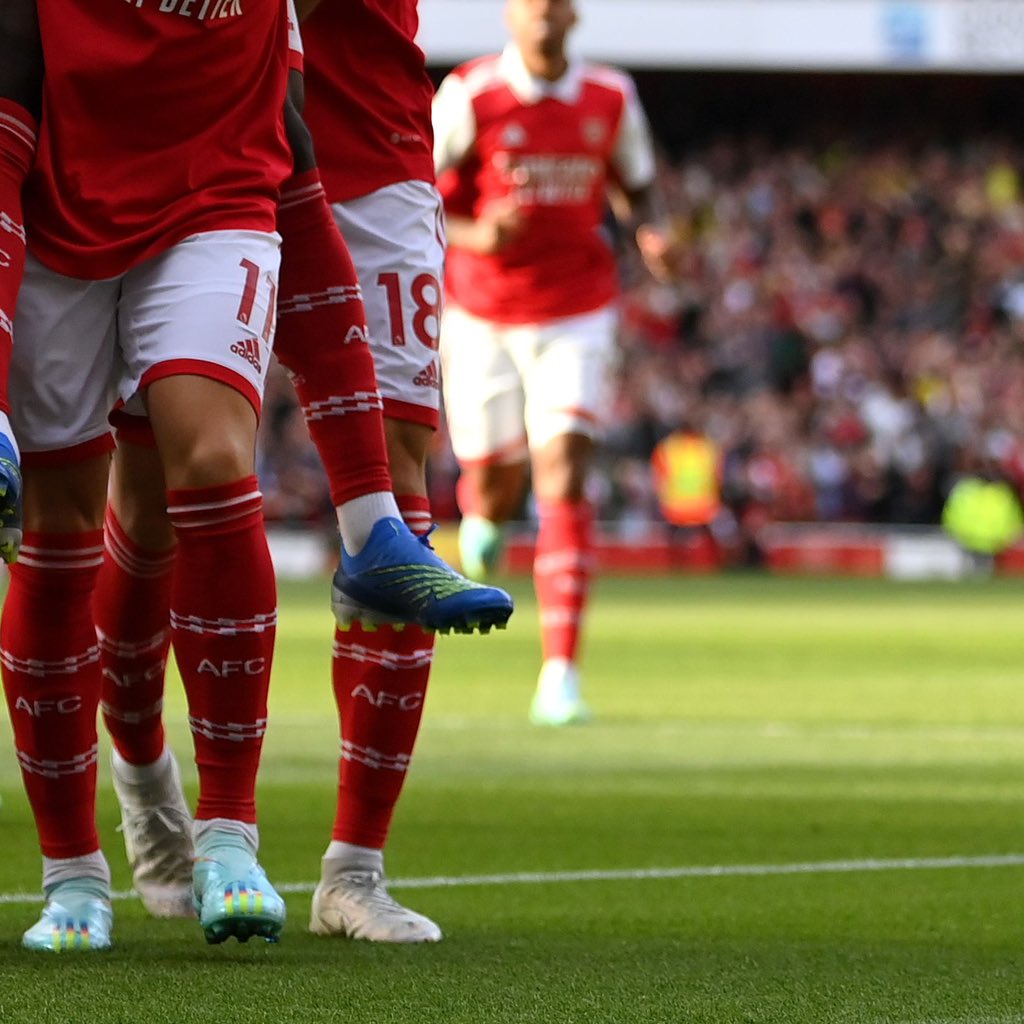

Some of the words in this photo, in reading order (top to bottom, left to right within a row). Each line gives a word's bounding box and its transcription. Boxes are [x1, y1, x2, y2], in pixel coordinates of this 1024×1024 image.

[377, 272, 441, 351] 18
[197, 657, 265, 677] AFC
[15, 695, 82, 718] AFC
[351, 684, 423, 711] AFC
